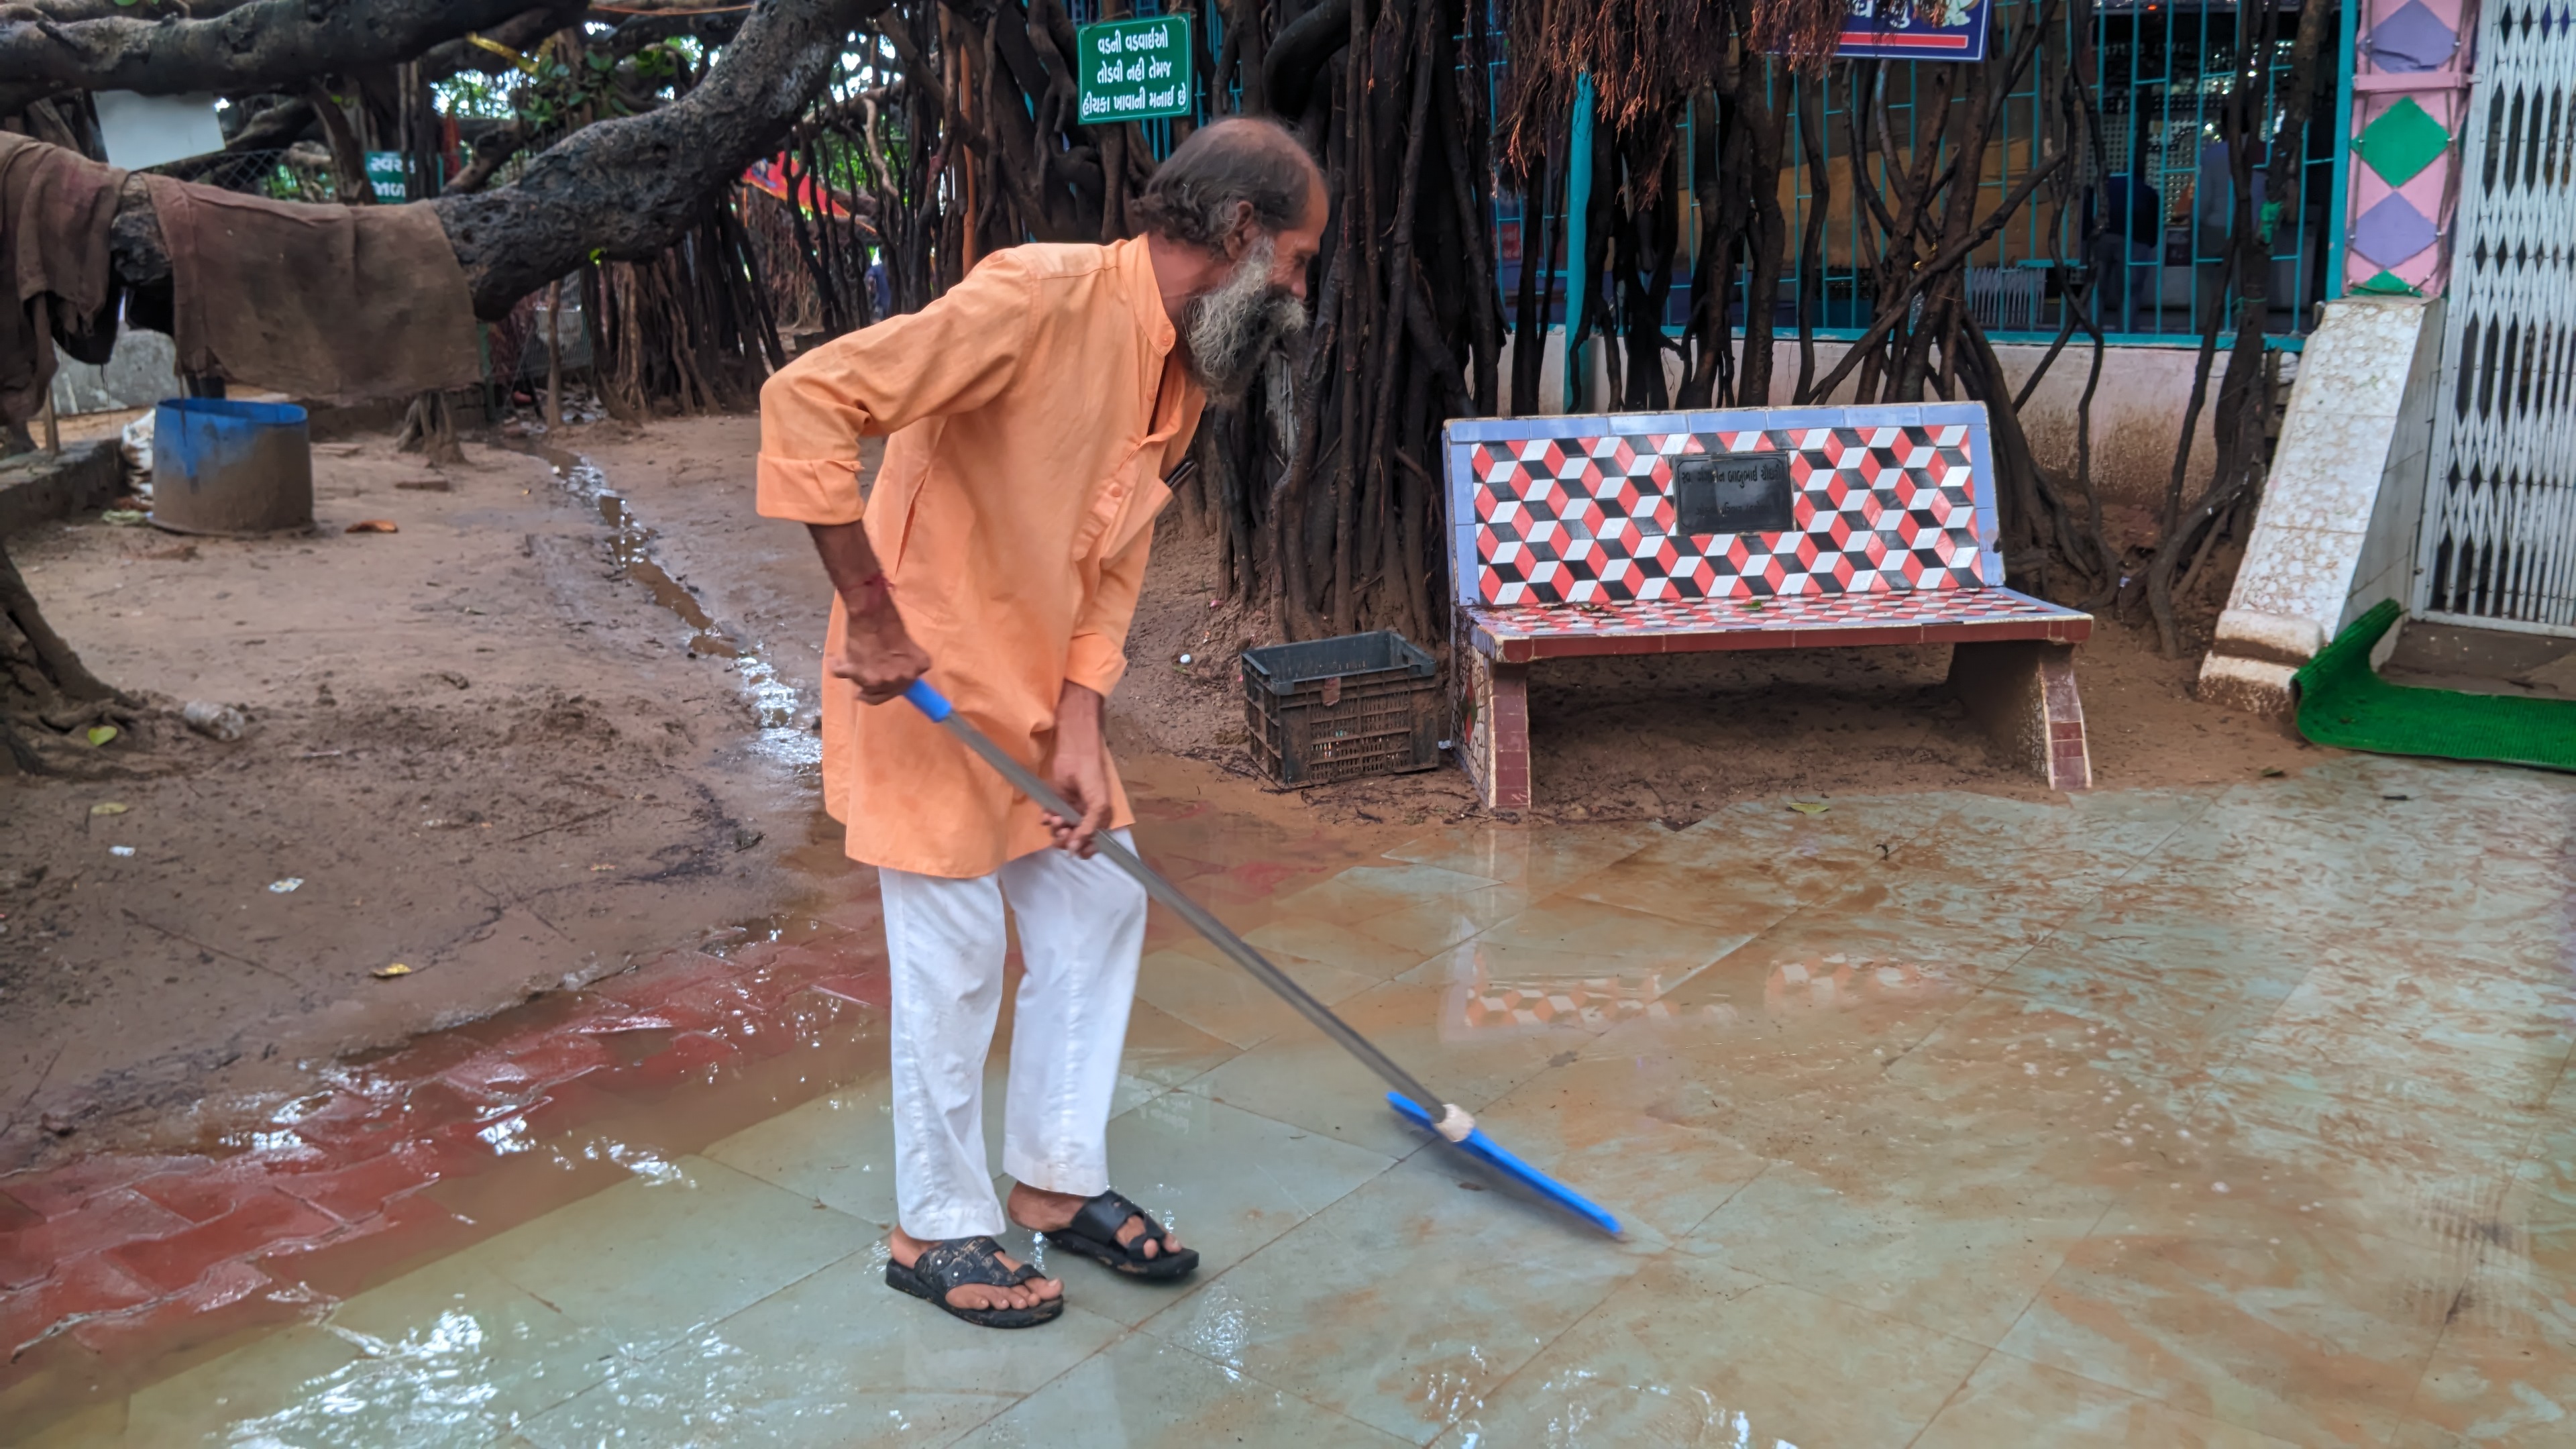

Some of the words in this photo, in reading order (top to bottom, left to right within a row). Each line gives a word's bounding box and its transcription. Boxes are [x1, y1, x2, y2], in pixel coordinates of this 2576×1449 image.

[1097, 30, 1122, 54] વડની
[1125, 24, 1169, 52] વડવાઈઓ
[1097, 59, 1123, 84] તોડવી
[1126, 56, 1144, 82] નહી
[1148, 55, 1172, 79] તેમજ
[1082, 91, 1110, 116] હીચકા
[1114, 86, 1146, 111] ખાવાની
[1149, 85, 1175, 109] મનાઈ
[1177, 82, 1187, 106] છે
